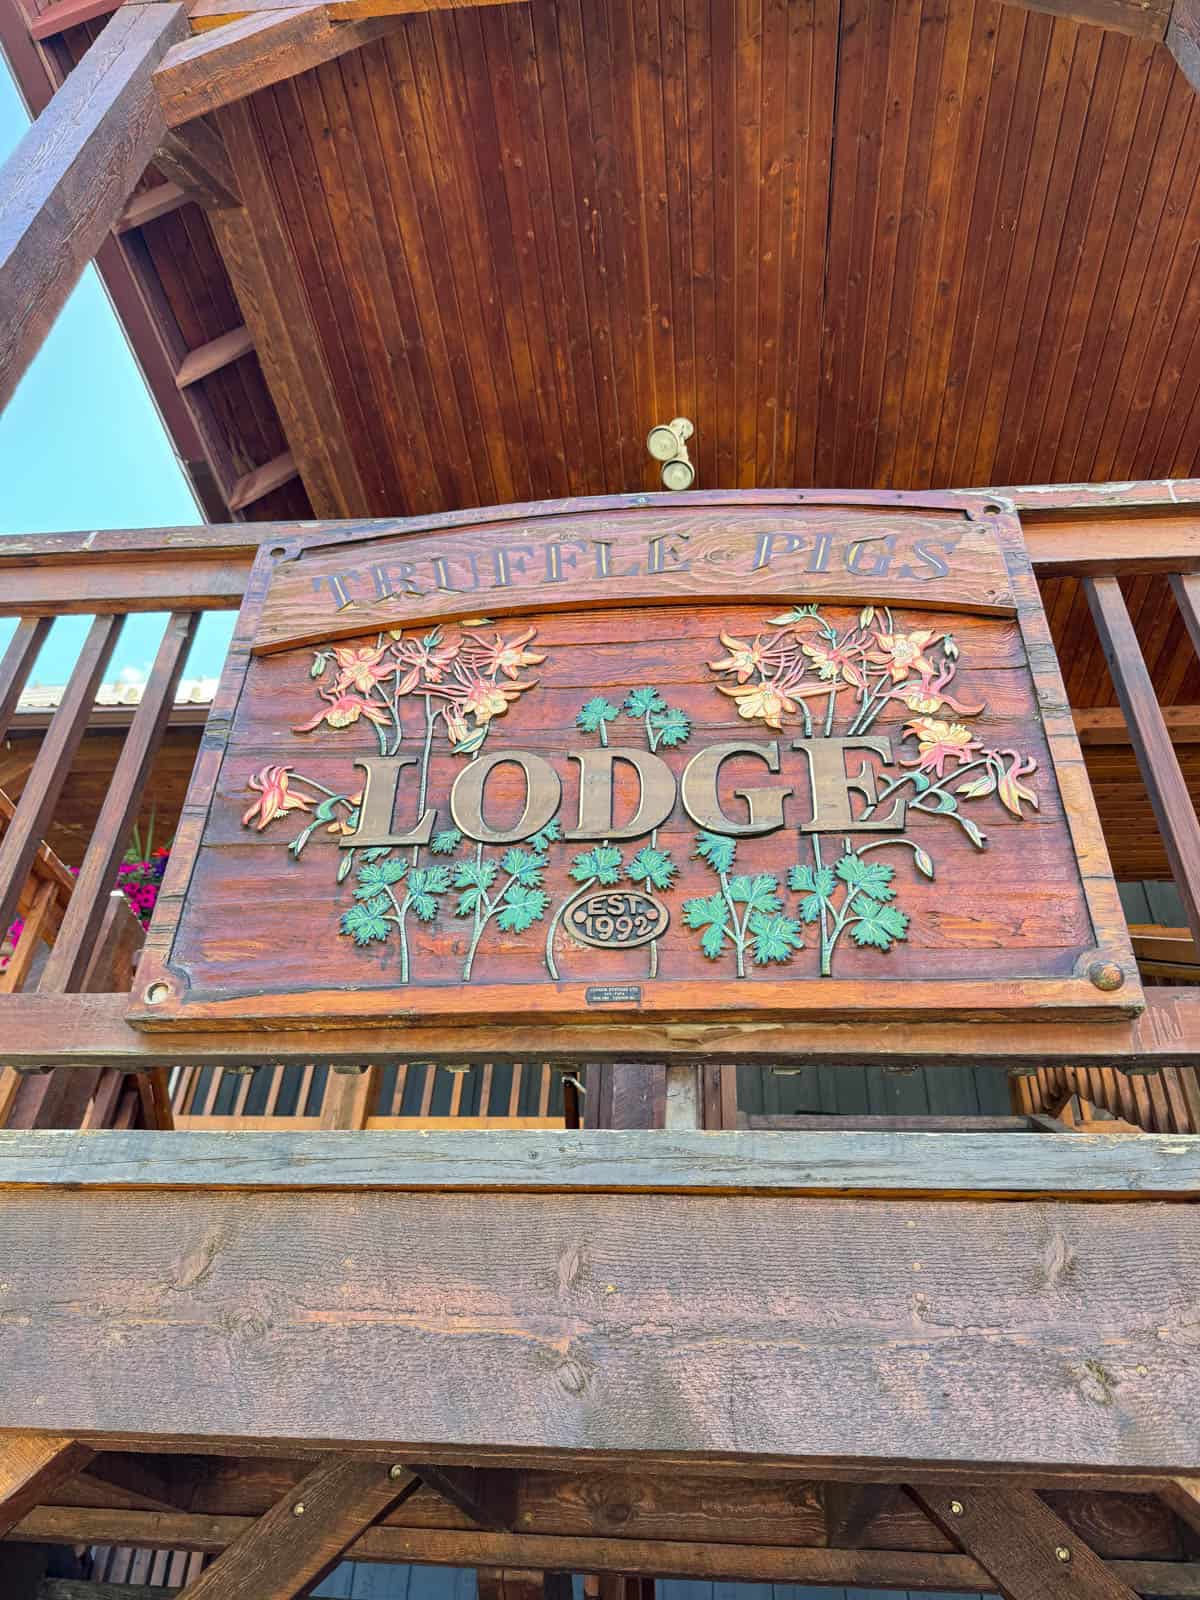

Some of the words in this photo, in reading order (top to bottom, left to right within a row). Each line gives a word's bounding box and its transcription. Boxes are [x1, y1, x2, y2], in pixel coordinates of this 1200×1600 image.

[312, 533, 691, 612] TRUFFLE
[749, 531, 957, 581] PIGS
[339, 735, 906, 847] LODGE
[585, 915, 652, 940] 1992
